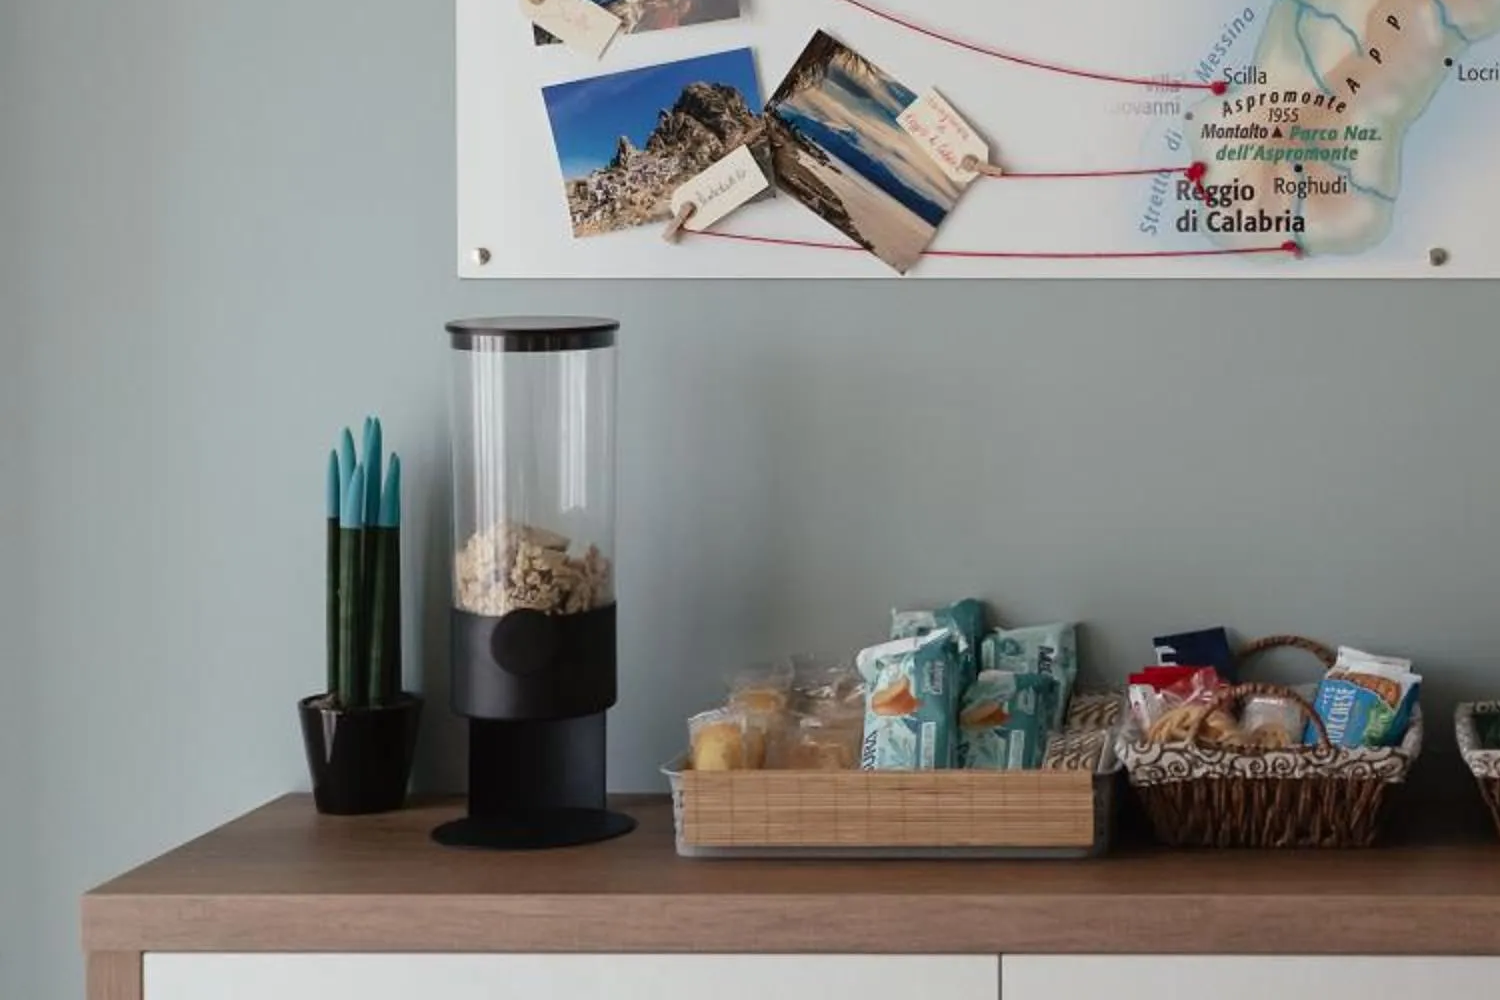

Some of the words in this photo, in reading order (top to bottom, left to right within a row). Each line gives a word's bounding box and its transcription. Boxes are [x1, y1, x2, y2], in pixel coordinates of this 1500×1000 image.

[1168, 129, 1184, 153] di
[1193, 6, 1256, 84] Messina
[1223, 66, 1268, 86] Scilla
[1457, 63, 1500, 82] Locri
[1222, 88, 1348, 118] Aspromonte
[1267, 107, 1300, 123] 1955
[1201, 123, 1269, 140] Montalto
[1289, 125, 1338, 142] Parco
[1343, 125, 1383, 142] Naz.
[1215, 145, 1359, 164] dell'Aspromonte
[1175, 179, 1255, 208] Reggio
[1273, 176, 1348, 198] Roghudi
[1176, 210, 1199, 233] di
[1205, 210, 1306, 233] Calabria
